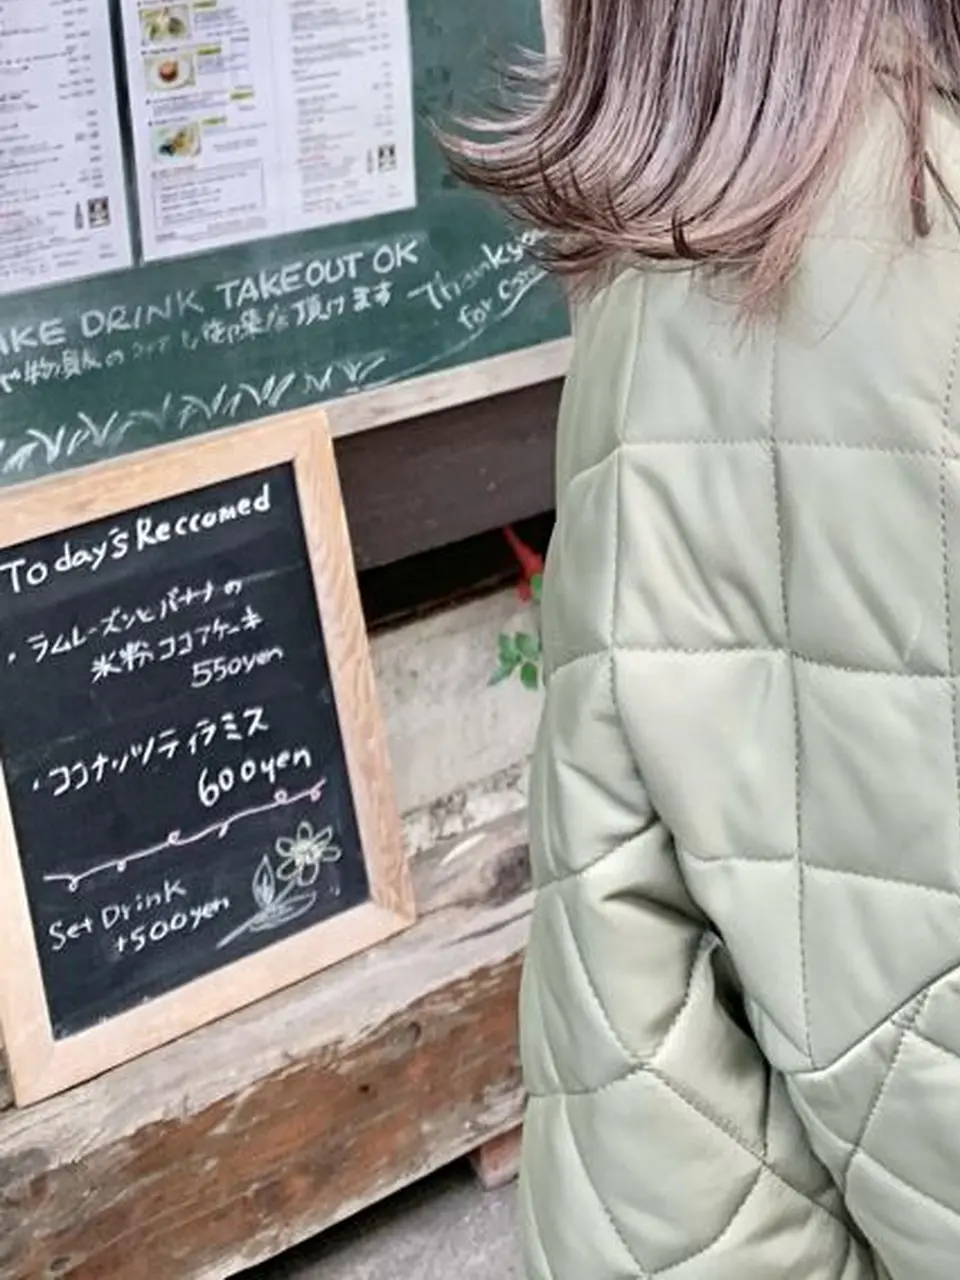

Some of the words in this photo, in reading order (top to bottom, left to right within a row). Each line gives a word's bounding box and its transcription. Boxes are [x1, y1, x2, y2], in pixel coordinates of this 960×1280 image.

[80, 289, 204, 338] DRINK
[372, 239, 419, 274] OK
[457, 297, 493, 330] for
[0, 527, 128, 593] Today's
[191, 646, 284, 688] 550yen
[199, 747, 311, 807] 600yen
[48, 914, 92, 950] Set
[101, 880, 187, 926] Drink
[115, 895, 230, 954] +500yen
